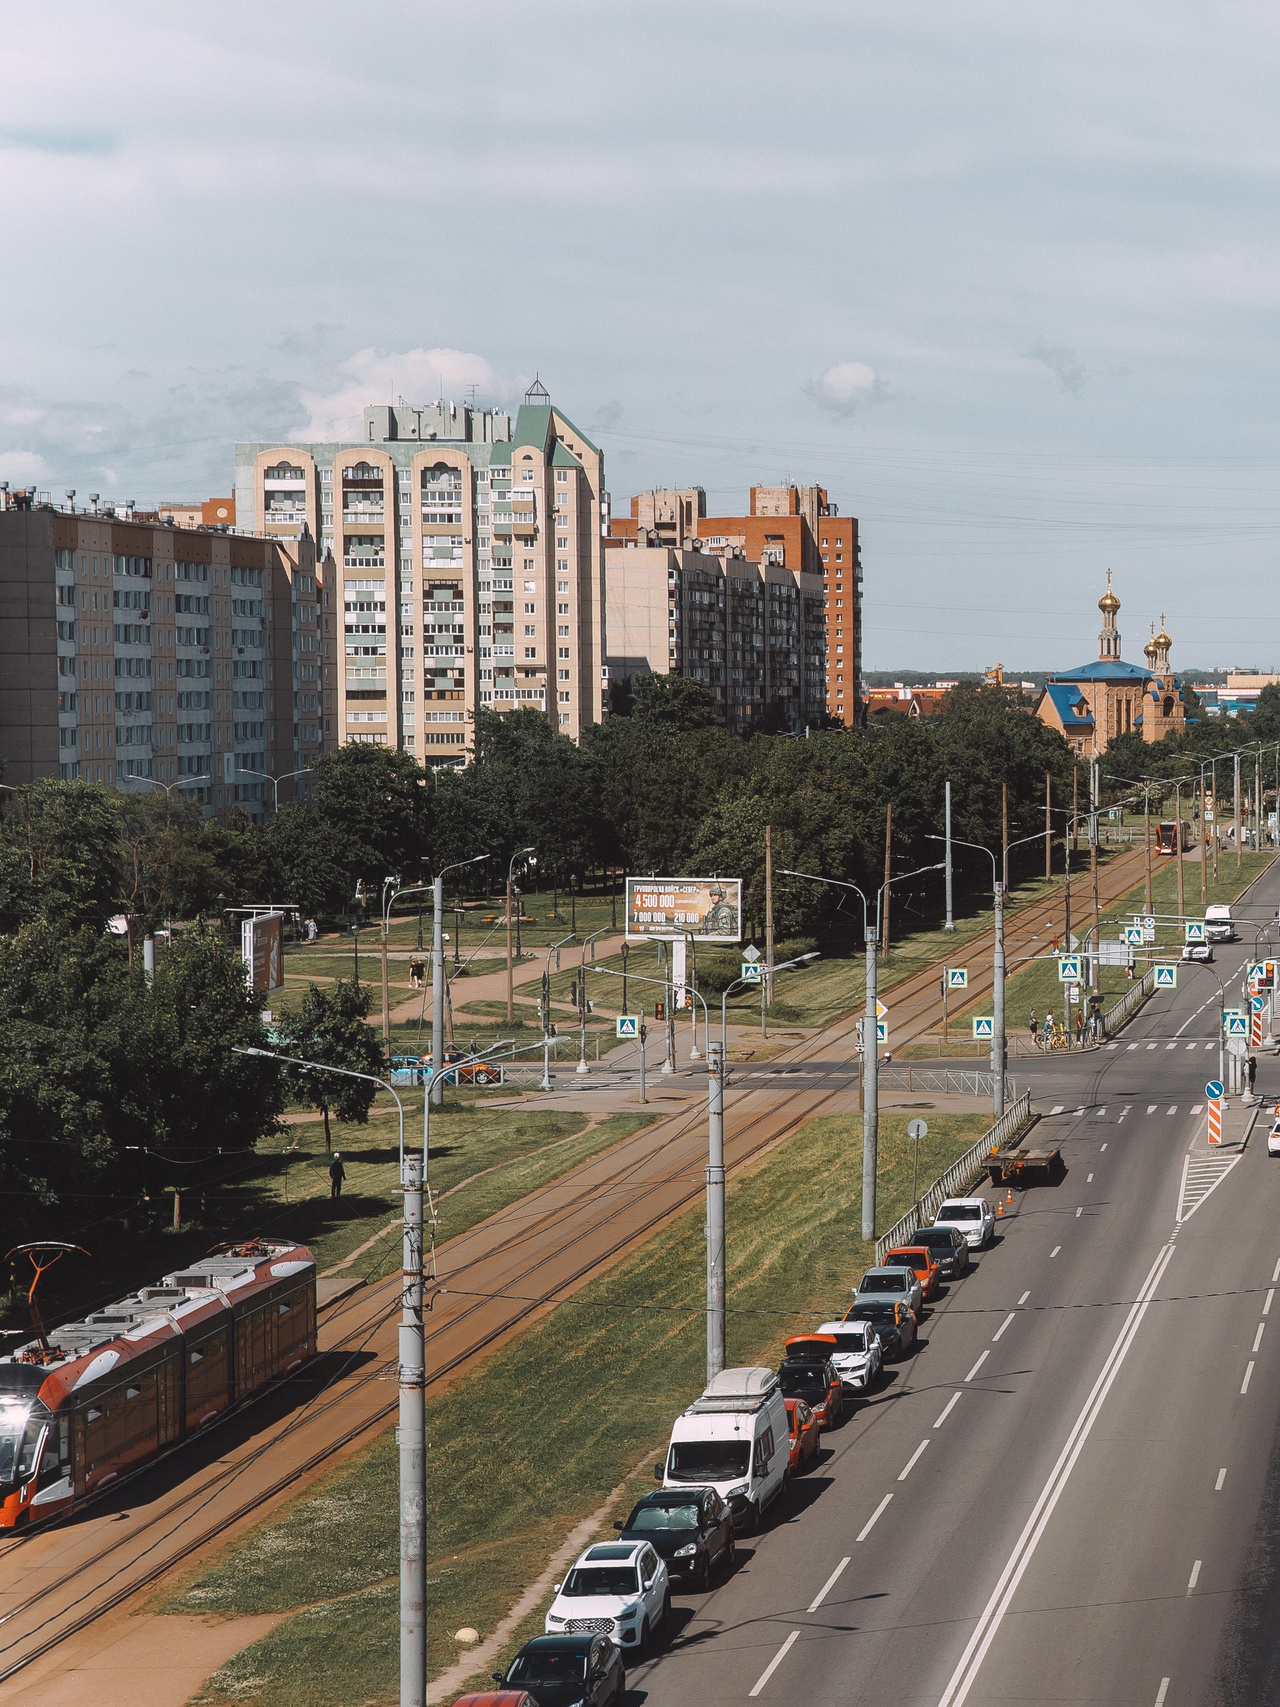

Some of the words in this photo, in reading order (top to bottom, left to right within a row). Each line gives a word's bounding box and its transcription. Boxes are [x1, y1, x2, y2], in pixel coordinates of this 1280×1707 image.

[636, 894, 641, 908] 4
[642, 894, 658, 908] 500
[660, 894, 675, 908] 000
